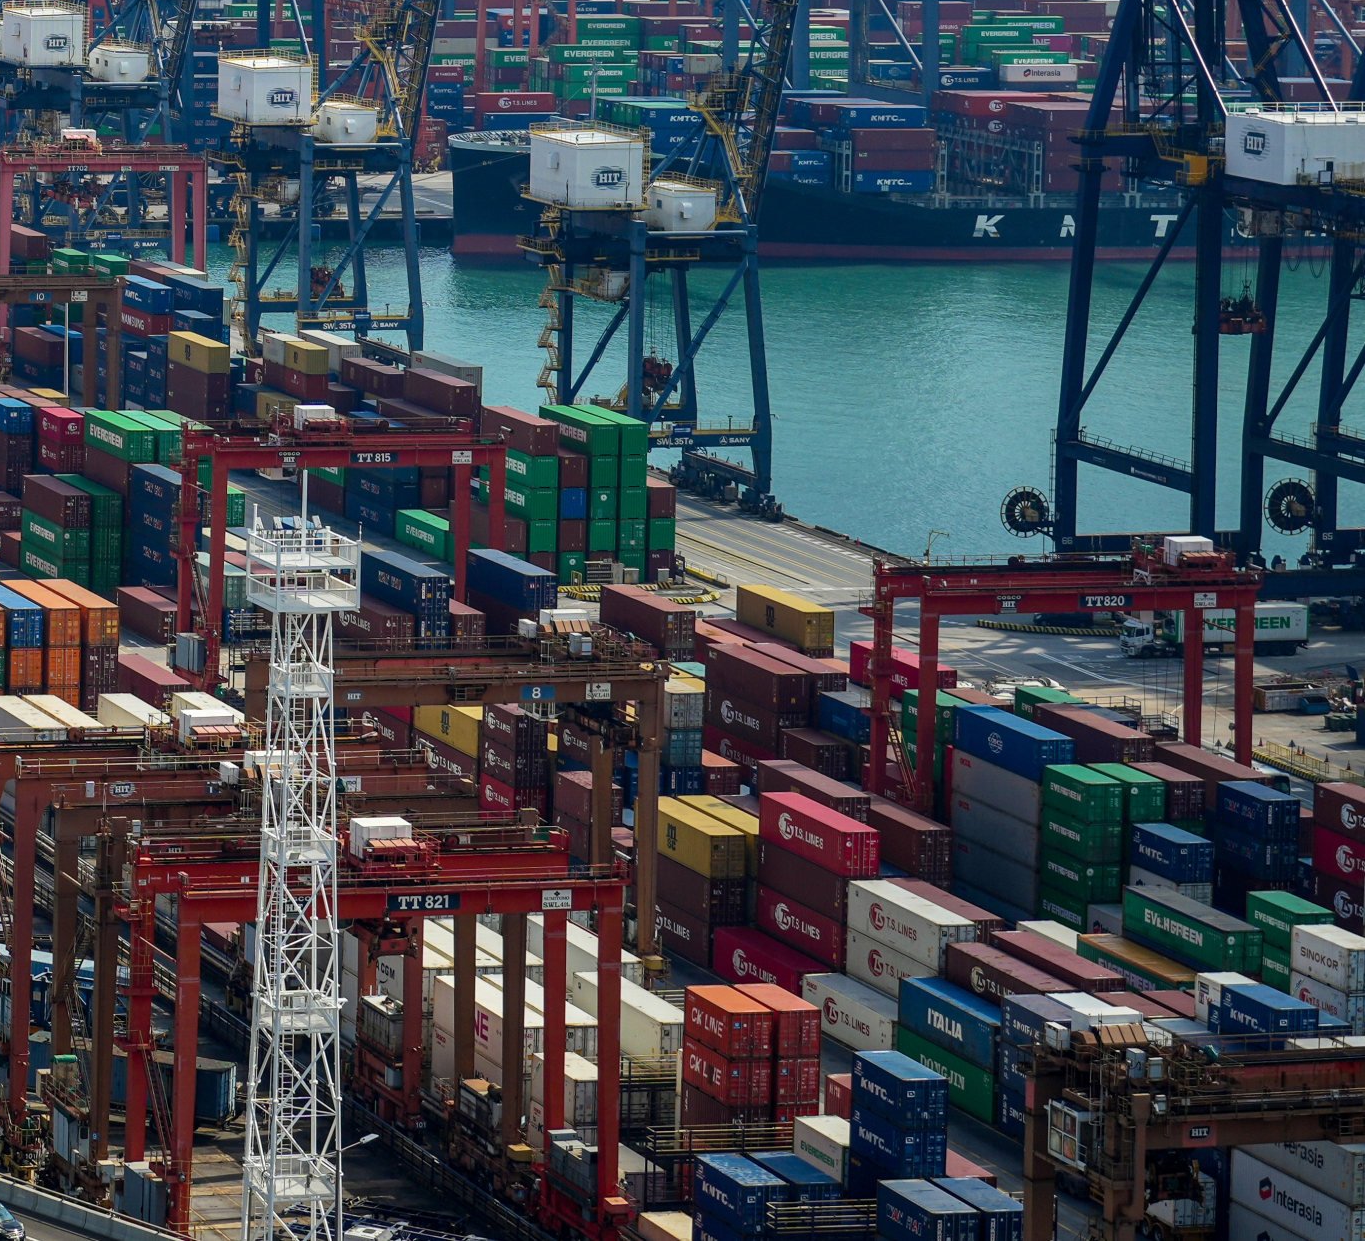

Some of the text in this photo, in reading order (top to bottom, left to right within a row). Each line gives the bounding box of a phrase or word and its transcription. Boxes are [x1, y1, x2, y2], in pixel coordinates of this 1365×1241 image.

[48, 39, 66, 47] HIT
[1031, 68, 1061, 77] Interasia
[274, 93, 292, 103] HIT
[1246, 135, 1263, 151] HIT
[598, 172, 620, 184] HIT
[973, 214, 1005, 238] K
[90, 423, 123, 449] EVERGREEN
[673, 437, 694, 445] 35Te
[357, 452, 391, 463] TT 815
[30, 522, 55, 542] EVERGREEN
[405, 524, 435, 545] EVERGREEN
[26, 552, 58, 578] EVERGREEN
[1085, 596, 1124, 606] TT820
[532, 687, 541, 699] 8
[734, 710, 760, 730] T.S. LINES
[114, 785, 130, 793] HIT
[1051, 782, 1081, 802] EVERGREEN
[795, 827, 824, 849] T.S. LINES
[1049, 822, 1080, 842] EVERGREEN
[1139, 845, 1162, 862] KMTC
[1048, 862, 1078, 881] EVERGREEN
[398, 894, 449, 909] TT 821
[1042, 899, 1082, 926] EVERGREEN
[1255, 910, 1290, 932] EVERGREEN
[886, 917, 917, 941] T.S. LINES
[1144, 909, 1203, 947] EVERGREEN
[1300, 946, 1338, 971] SINOKOR
[380, 964, 395, 980] CGM
[748, 962, 777, 985] T.S. LINES
[691, 1008, 724, 1038] CK LINE
[840, 1012, 870, 1036] T.S. LINES
[927, 1008, 963, 1042] ITALIA
[1230, 1009, 1257, 1030] KMTC
[861, 1077, 887, 1101] KMTC
[859, 1126, 884, 1148] KMTC
[1191, 1127, 1210, 1137] HIT
[801, 1140, 835, 1168] EVERGREEN
[702, 1181, 728, 1203] KMTC
[1273, 1184, 1322, 1226] Interasia
